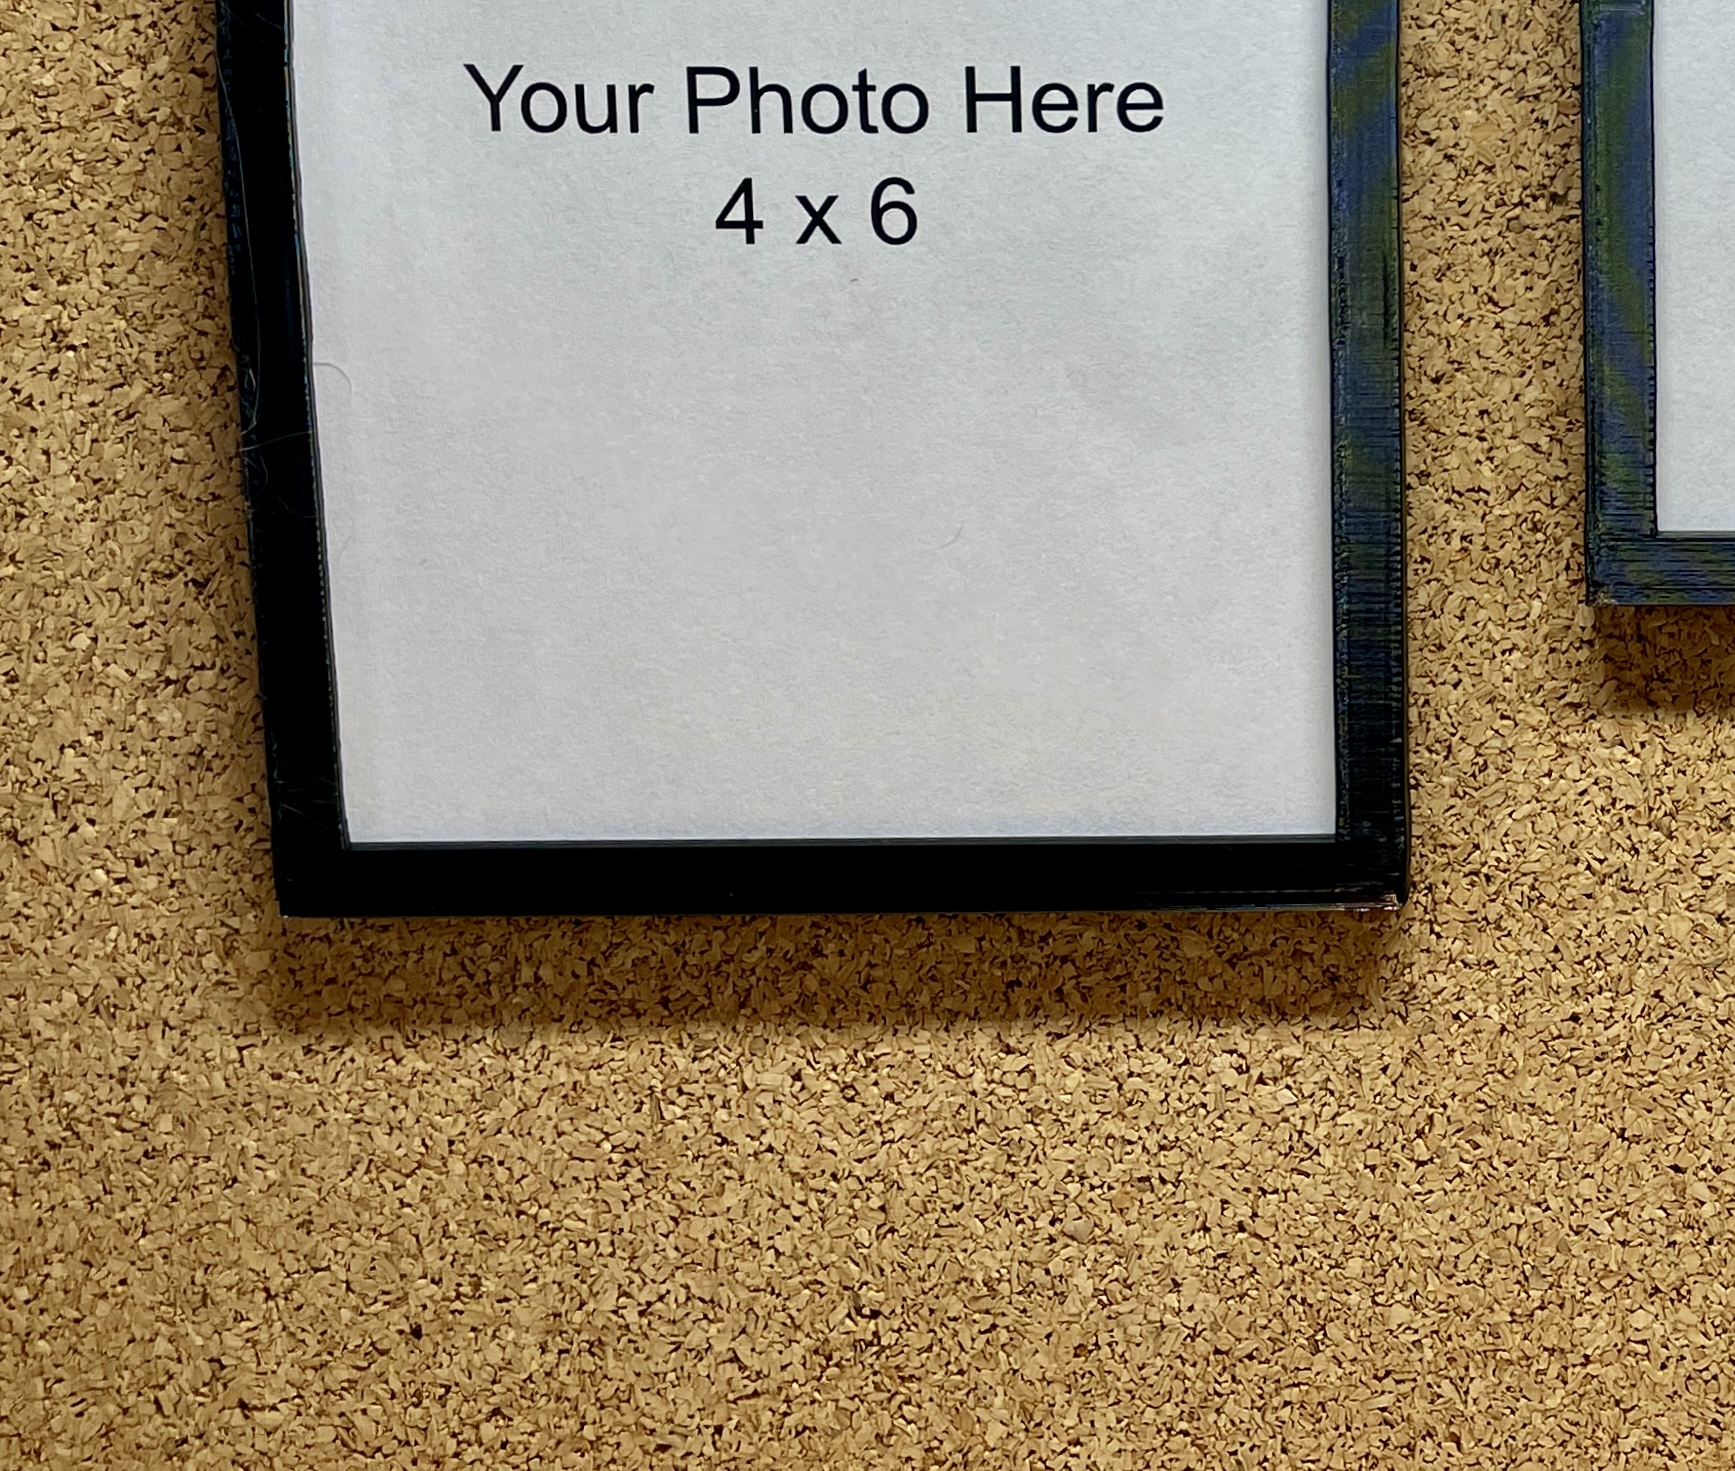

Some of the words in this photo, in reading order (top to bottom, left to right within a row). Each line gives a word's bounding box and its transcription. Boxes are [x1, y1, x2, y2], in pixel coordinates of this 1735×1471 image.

[462, 62, 656, 136] Your
[685, 65, 930, 136] Photo
[963, 64, 1165, 135] Here
[714, 176, 765, 246] 4
[793, 193, 843, 246] x
[869, 175, 919, 247] 6
